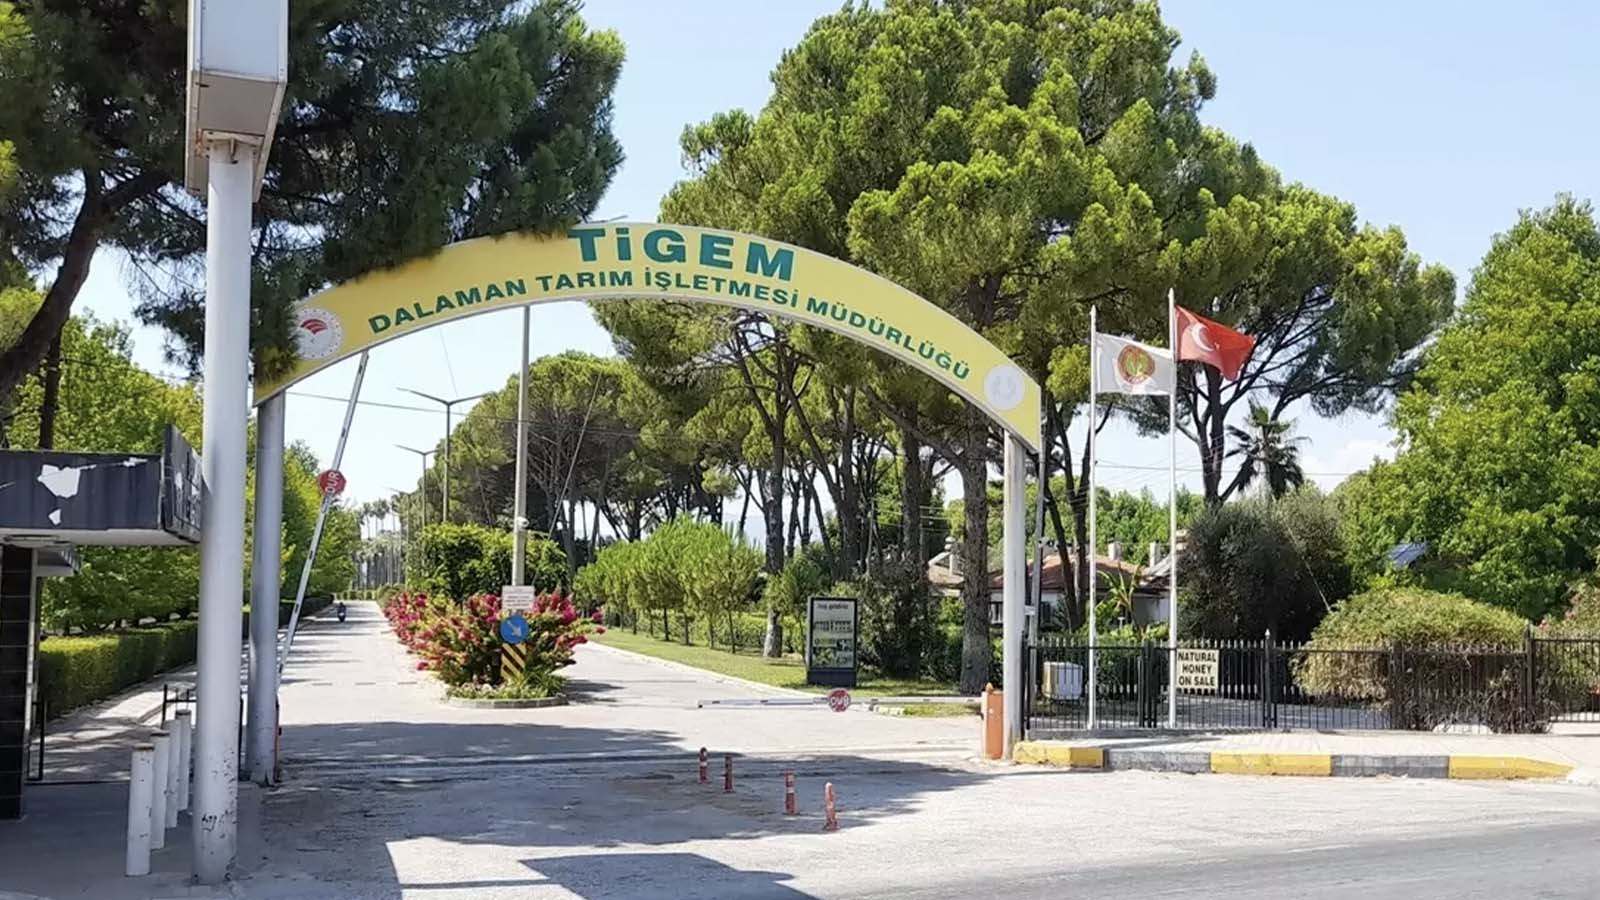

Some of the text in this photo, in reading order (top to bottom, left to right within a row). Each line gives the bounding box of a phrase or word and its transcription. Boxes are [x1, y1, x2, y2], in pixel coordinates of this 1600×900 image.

[368, 267, 970, 380] DALAMAN TARIM İŞLETMESİ MÜDÜRLÜĞÜ
[1178, 652, 1216, 662] NATURAL
[1182, 664, 1212, 674] HONEY
[1179, 676, 1215, 686] ON SALE
